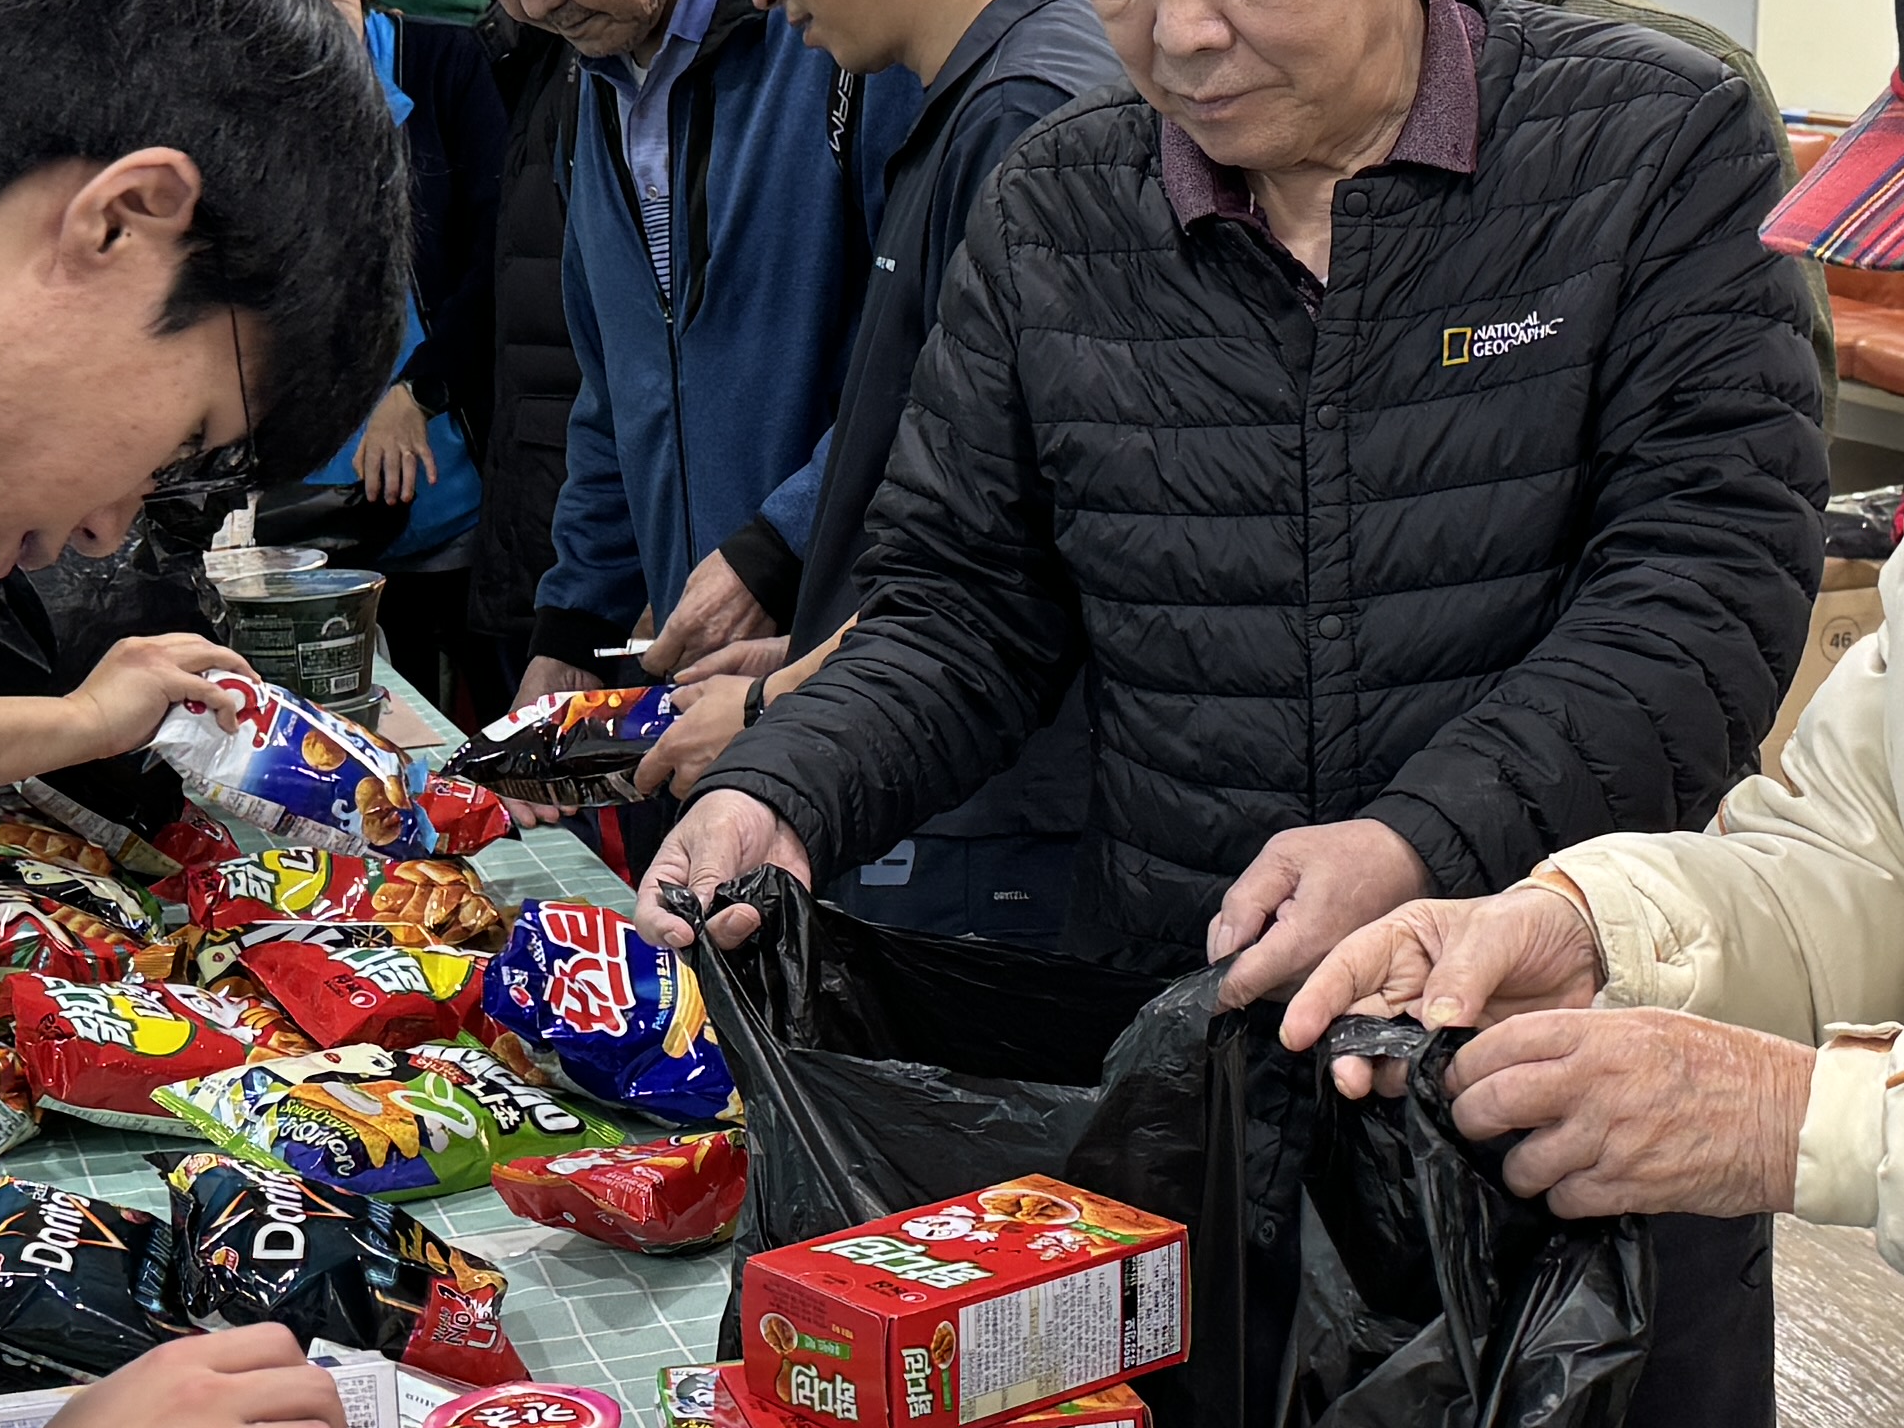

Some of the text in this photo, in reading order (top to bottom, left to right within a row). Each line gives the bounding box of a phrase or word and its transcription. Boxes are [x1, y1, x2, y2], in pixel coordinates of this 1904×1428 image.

[810, 1233, 996, 1290] 닭다리
[790, 1364, 861, 1423] 닭다리
[902, 1346, 934, 1421] 닭다리
